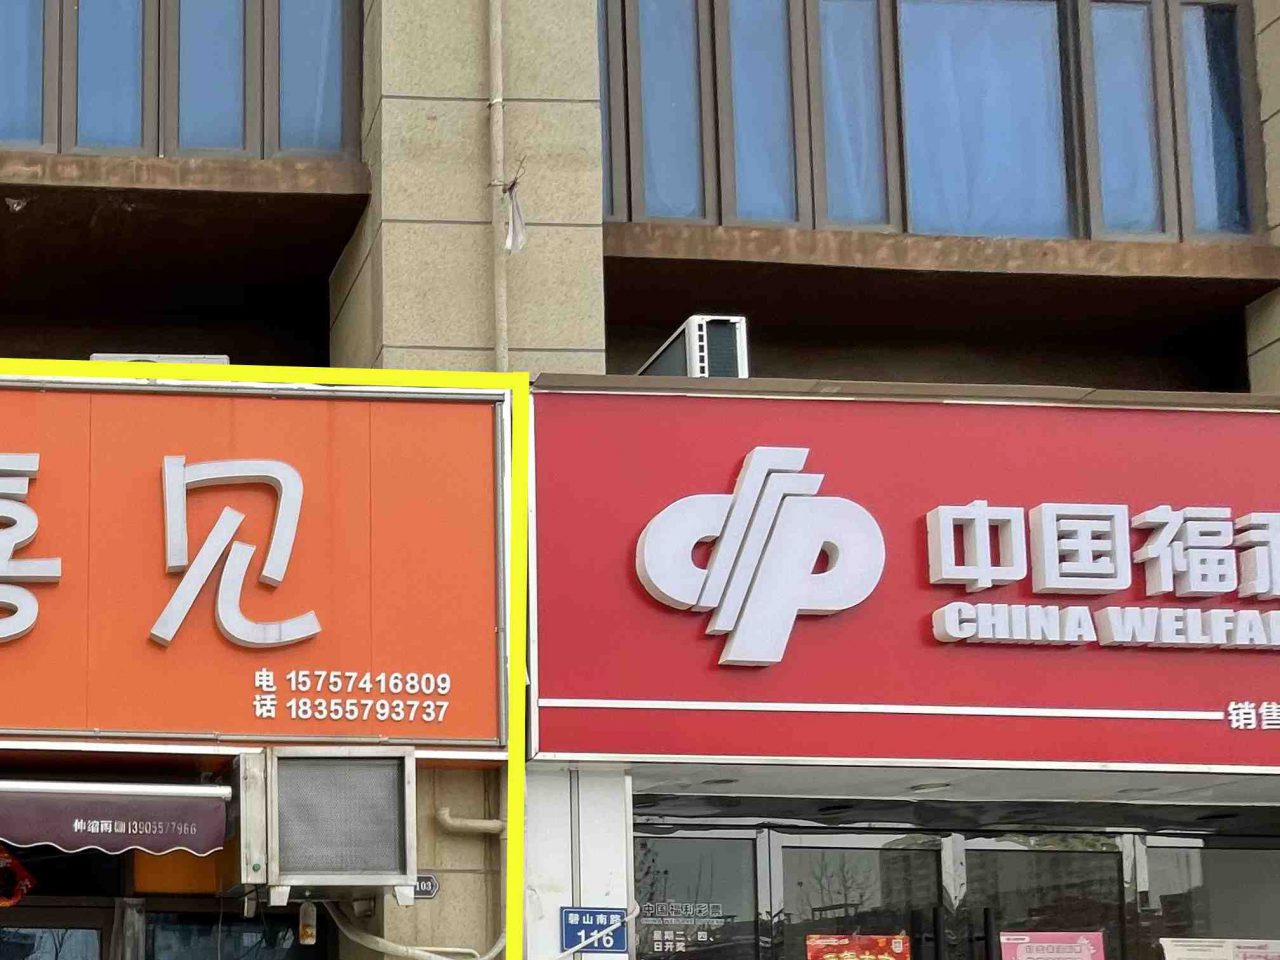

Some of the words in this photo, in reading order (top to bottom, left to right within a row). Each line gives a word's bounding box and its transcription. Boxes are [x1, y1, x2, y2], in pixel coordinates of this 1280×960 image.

[932, 601, 1097, 643] CHINA
[1095, 605, 1280, 648] WELFA
[286, 670, 451, 694] 15757416809
[286, 698, 450, 721] 18355793737
[642, 903, 723, 917] 中国福利彩票
[577, 929, 614, 948] 116
[653, 942, 686, 952] 日开奖
